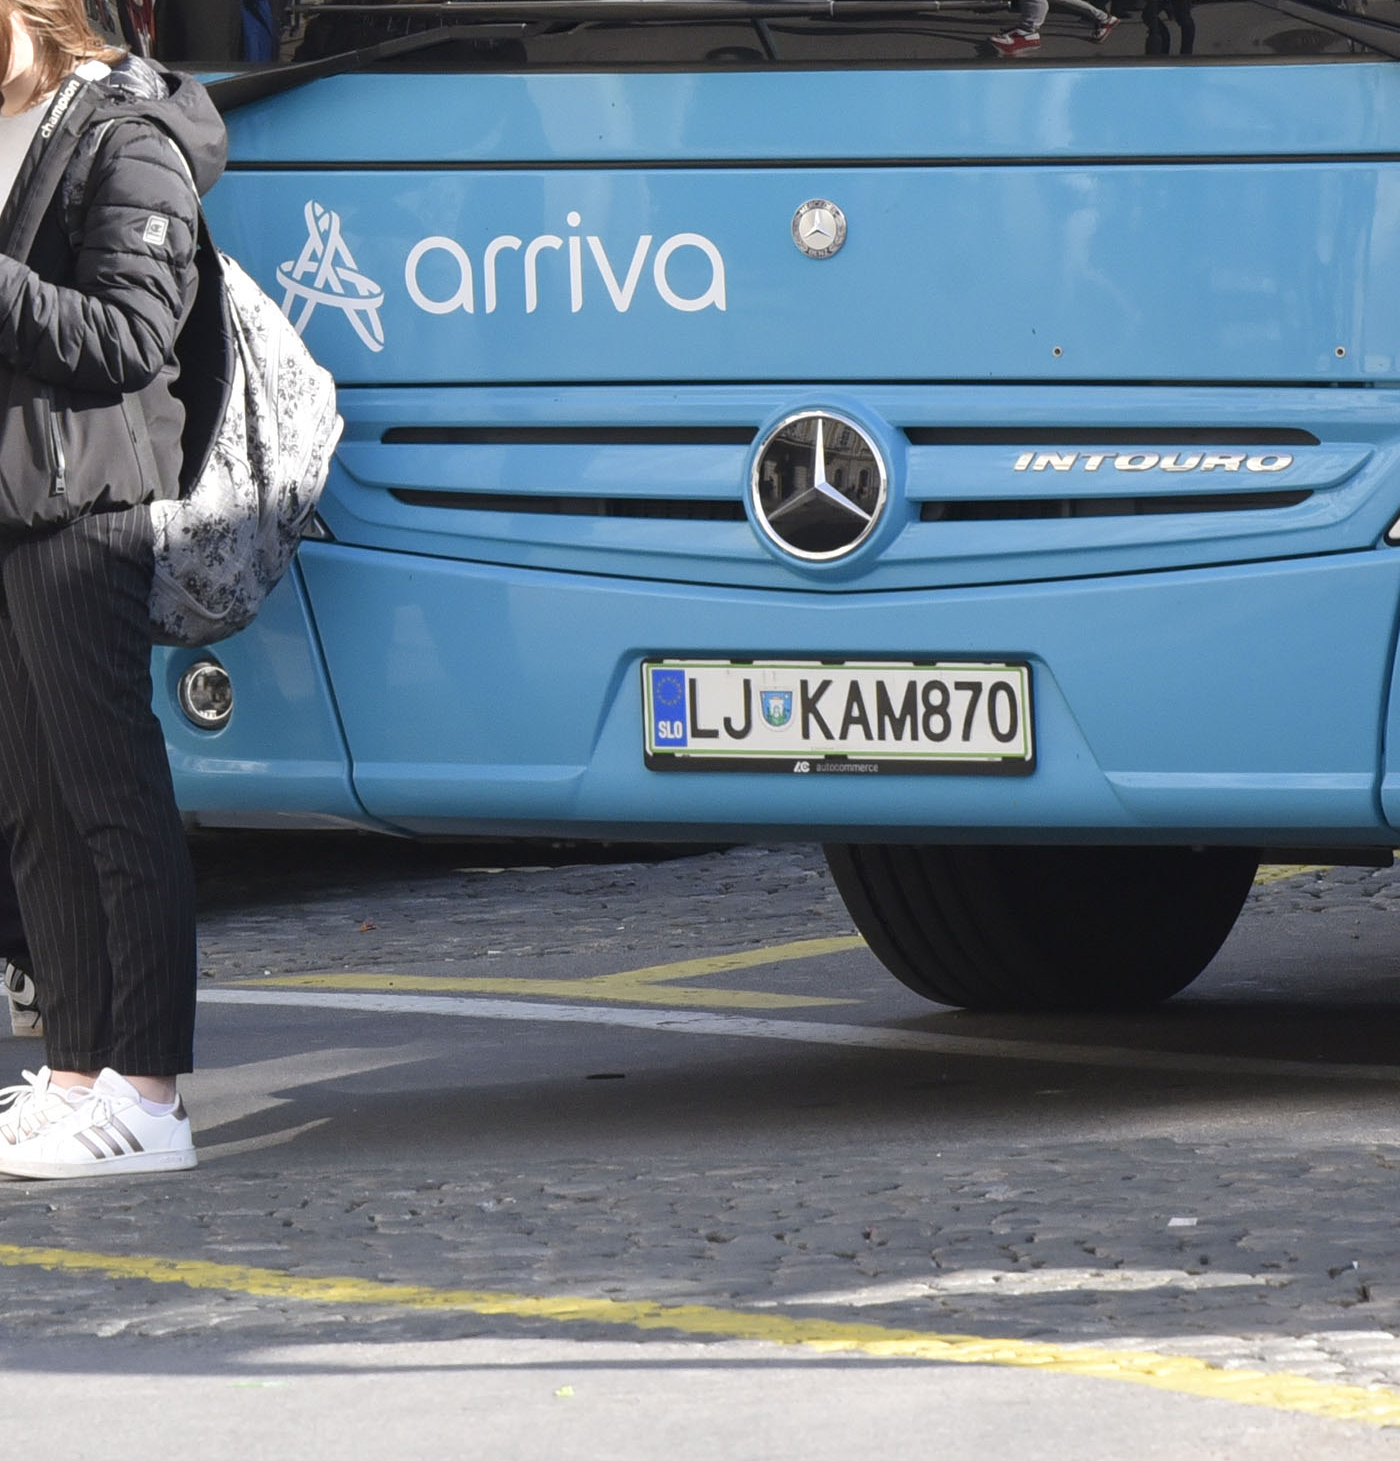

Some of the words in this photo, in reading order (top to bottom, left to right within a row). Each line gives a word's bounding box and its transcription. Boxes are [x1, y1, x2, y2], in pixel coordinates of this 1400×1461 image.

[41, 79, 80, 139] champion
[403, 210, 728, 314] arriva
[1012, 452, 1294, 474] INTOURO
[658, 721, 683, 739] SLO
[689, 678, 752, 740] LJ
[801, 679, 1019, 743] KAM870
[816, 762, 879, 773] autocommerce
